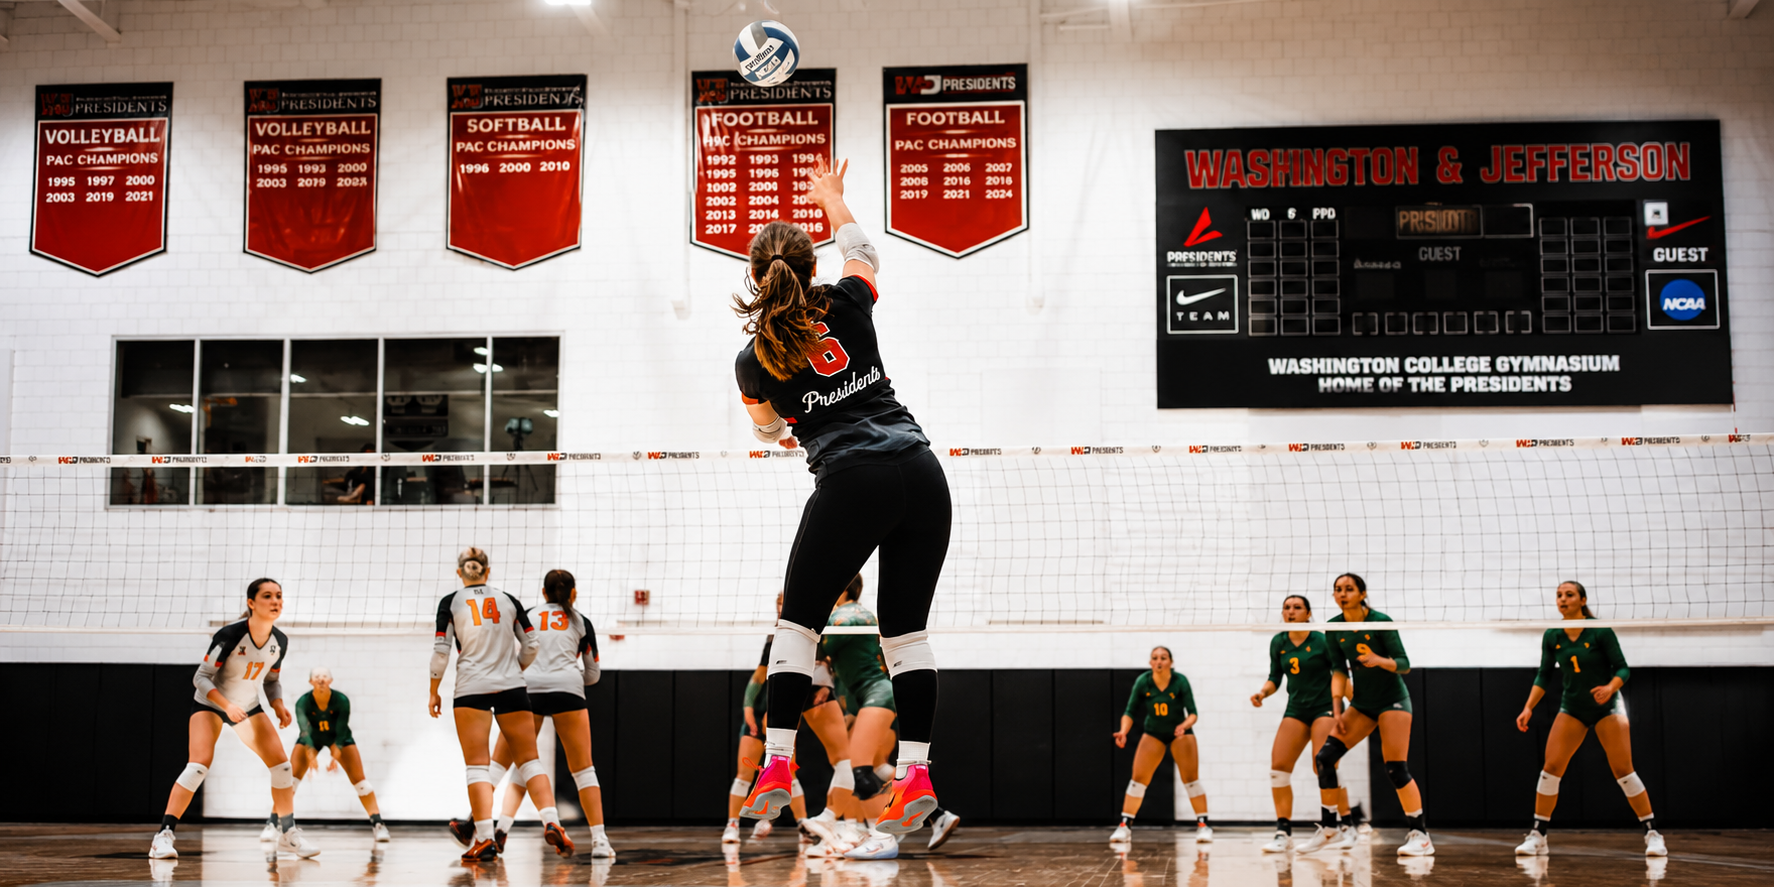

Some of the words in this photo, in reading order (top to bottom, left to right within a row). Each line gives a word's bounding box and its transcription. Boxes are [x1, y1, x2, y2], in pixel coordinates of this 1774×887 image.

[943, 76, 1016, 91] PRESIDENTS
[484, 92, 584, 106] PRESIDEN
[75, 100, 168, 114] PRESIDENTS
[467, 116, 567, 133] SOFTBALL
[711, 111, 819, 127] FOOTBALL
[906, 110, 1006, 126] FOOTBALL
[45, 127, 161, 144] VOLLEYBALL
[255, 121, 371, 137] VOLLEYBALL
[456, 142, 484, 153] PAC
[487, 139, 576, 152] CHAMPIONS
[737, 133, 826, 146] CHAMPIONS
[895, 140, 924, 151] PAC
[928, 137, 1017, 150] CHAMPIONS
[253, 144, 280, 155] PAC
[285, 143, 371, 155] CHAMPIONS
[46, 155, 73, 166] PAC
[77, 152, 159, 165] CHAMPIONS
[706, 154, 736, 166] 1992
[749, 154, 779, 165] 1993
[1184, 147, 1419, 189] WASHINGTON
[1437, 146, 1464, 184] &
[1480, 141, 1691, 183] JEFFERSON
[337, 162, 367, 173] 2000
[499, 162, 531, 173] 2000
[540, 161, 571, 172] 2010
[706, 168, 737, 180] 1995
[900, 163, 928, 174] 2005
[47, 176, 75, 187] 1995
[87, 175, 115, 186] 1997
[125, 175, 155, 186] 2000
[256, 177, 287, 189] 2003
[46, 192, 75, 203] 2003
[86, 191, 114, 202] 2019
[125, 191, 153, 202] 2021
[705, 195, 737, 207] 2002
[749, 195, 779, 206] 2004
[900, 189, 928, 200] 2019
[943, 189, 970, 200] 2021
[985, 189, 1013, 200] 2024
[705, 209, 736, 221] 2013
[749, 209, 779, 220] 2014
[705, 223, 737, 235] 2017
[1419, 247, 1461, 261] GUEST
[1653, 247, 1709, 262] GUEST
[1662, 297, 1707, 311] NCAA
[1176, 311, 1230, 321] TEAM
[806, 321, 850, 377] 6
[1268, 357, 1400, 374] WASHINGTON
[1404, 356, 1491, 373] COLLEGE
[1495, 355, 1620, 372] GYMNASIUM
[802, 365, 881, 413] Presidents
[1318, 377, 1374, 393] HOME
[1378, 377, 1404, 393] OF
[1407, 376, 1446, 392] THE
[1450, 375, 1572, 392] PRESIDENTS
[466, 597, 501, 626] 14
[538, 610, 569, 631] 13
[243, 661, 265, 680] 17
[1289, 657, 1300, 675] 3
[1570, 655, 1581, 673] 1
[1153, 702, 1168, 716] 10
